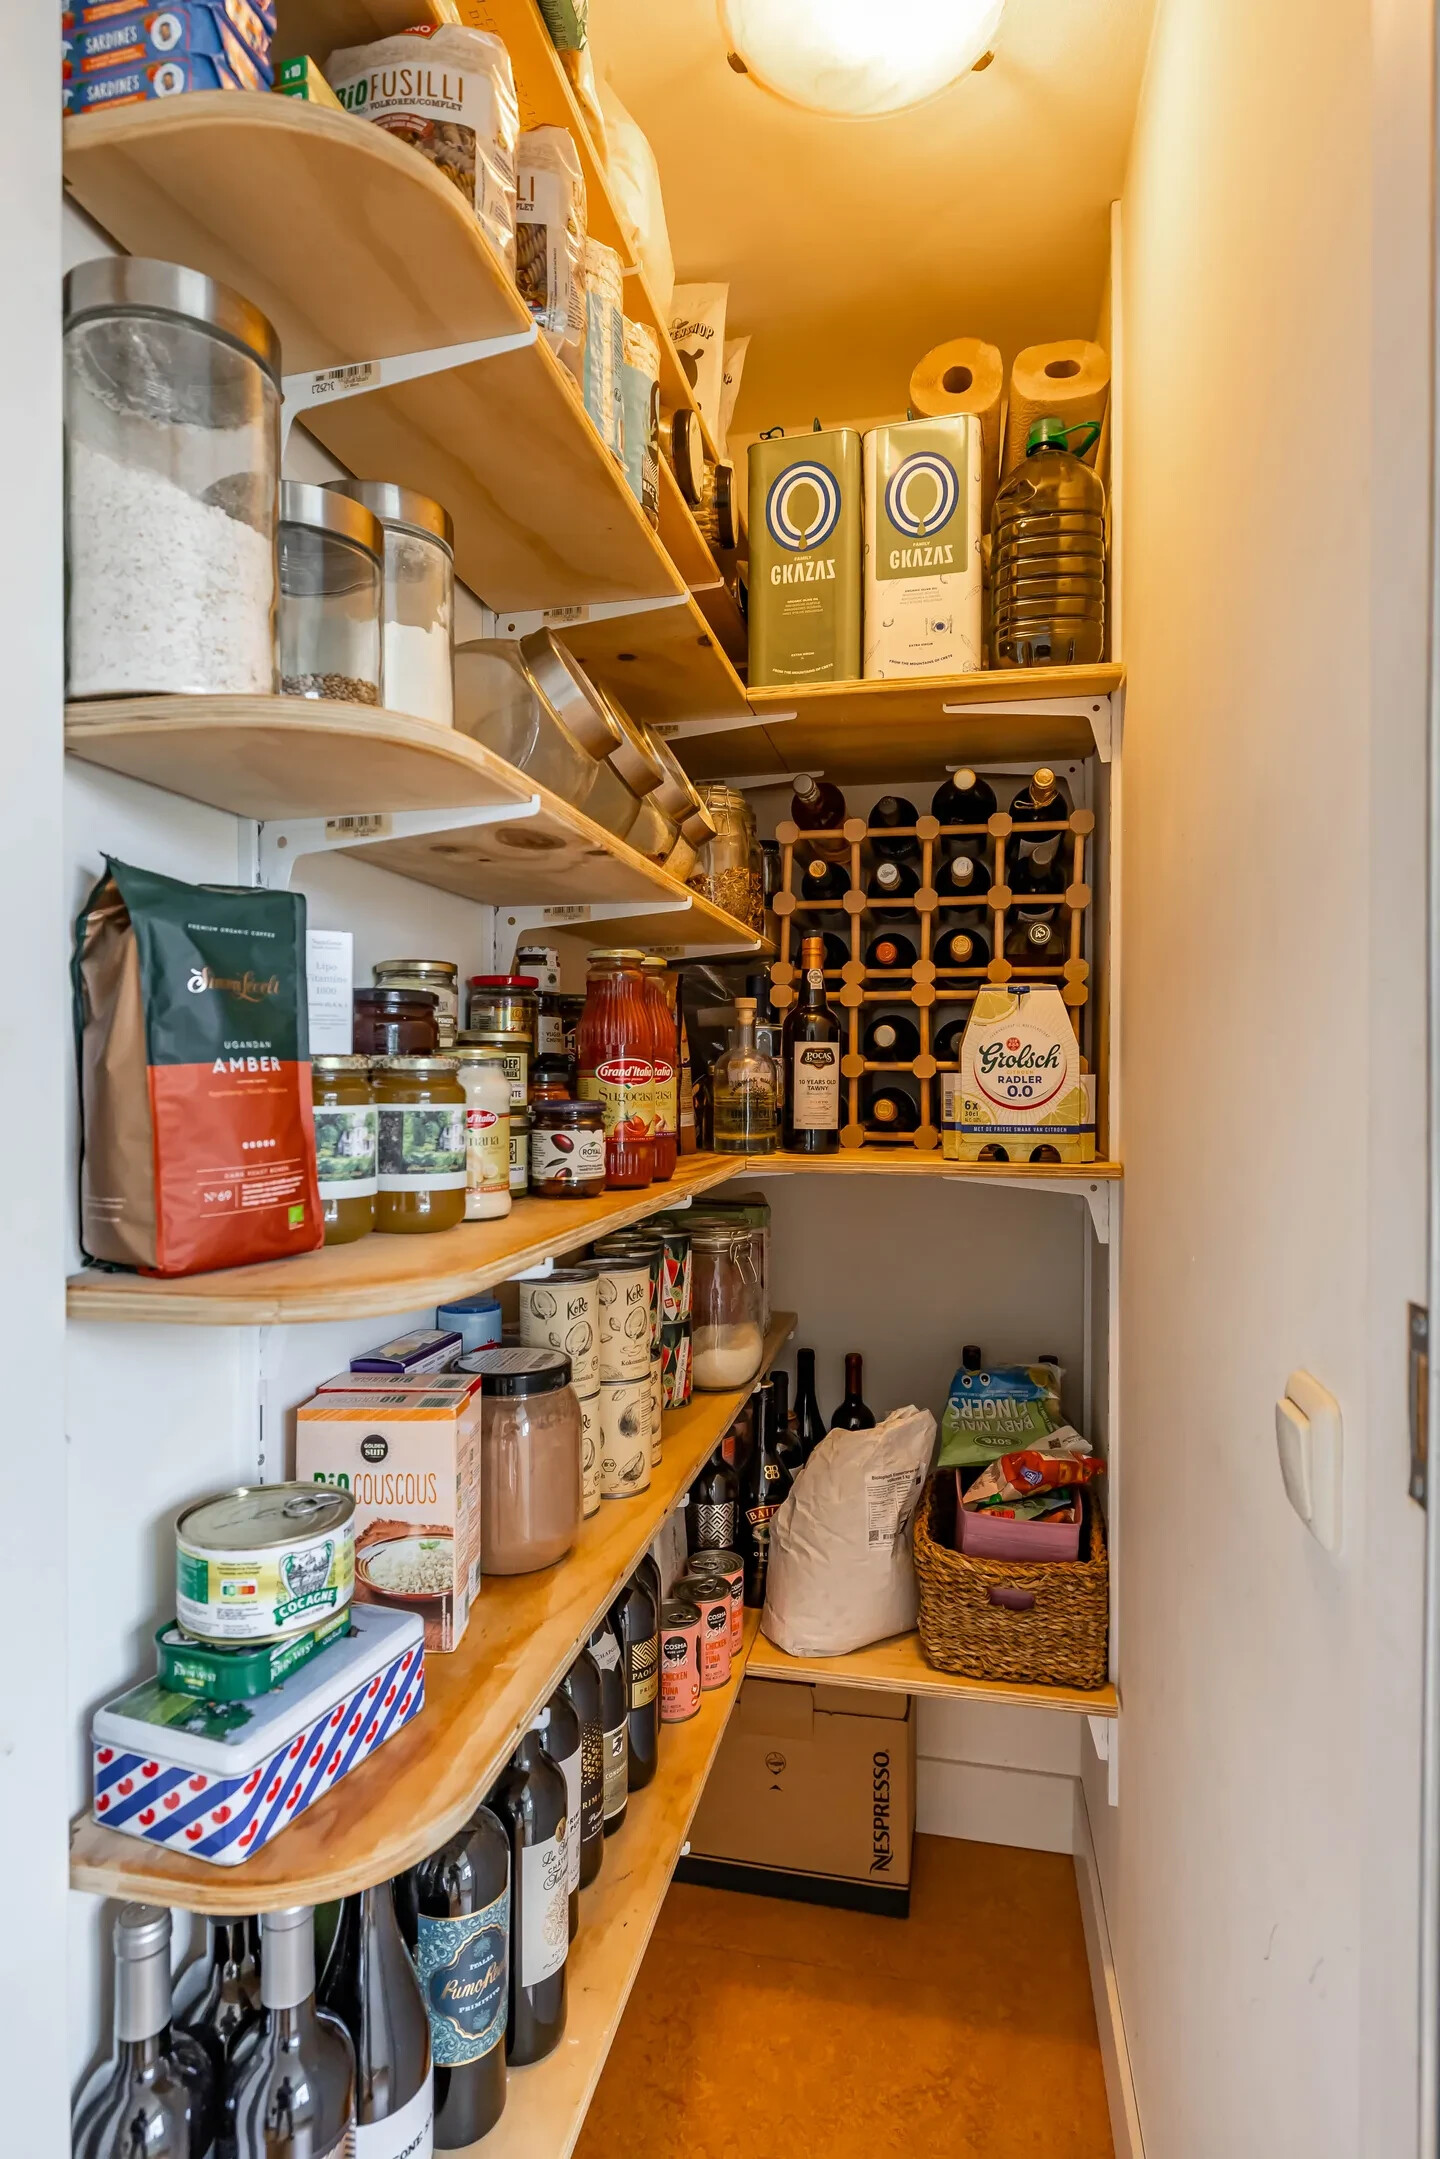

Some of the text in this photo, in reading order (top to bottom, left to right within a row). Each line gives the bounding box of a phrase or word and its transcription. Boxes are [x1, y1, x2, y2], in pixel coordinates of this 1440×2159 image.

[85, 25, 138, 54] SARDINES
[86, 74, 140, 103] SARDINES
[371, 69, 463, 103] FUSILLI
[224, 1041, 272, 1050] UGANDAN
[212, 1056, 282, 1075] AMBER
[979, 1042, 1061, 1074] Grolsch
[600, 1065, 653, 1077] Grand'Italia
[998, 1075, 1042, 1084] RADLER
[1007, 1085, 1033, 1098] 0.0
[950, 1397, 1028, 1420] FINGERS
[353, 1473, 437, 1505] COUSCOUS
[280, 1589, 335, 1618] COCAGNE
[708, 1611, 727, 1621] COSMA
[705, 1639, 727, 1650] CHICKEN
[705, 1654, 720, 1665] TUNA
[662, 1672, 688, 1680] CHICKEN
[662, 1687, 679, 1695] TUNA
[869, 1751, 894, 1876] NESPRESSO
[469, 1953, 494, 1971] ITALIA
[458, 1986, 501, 2014] PRIMITIVO
